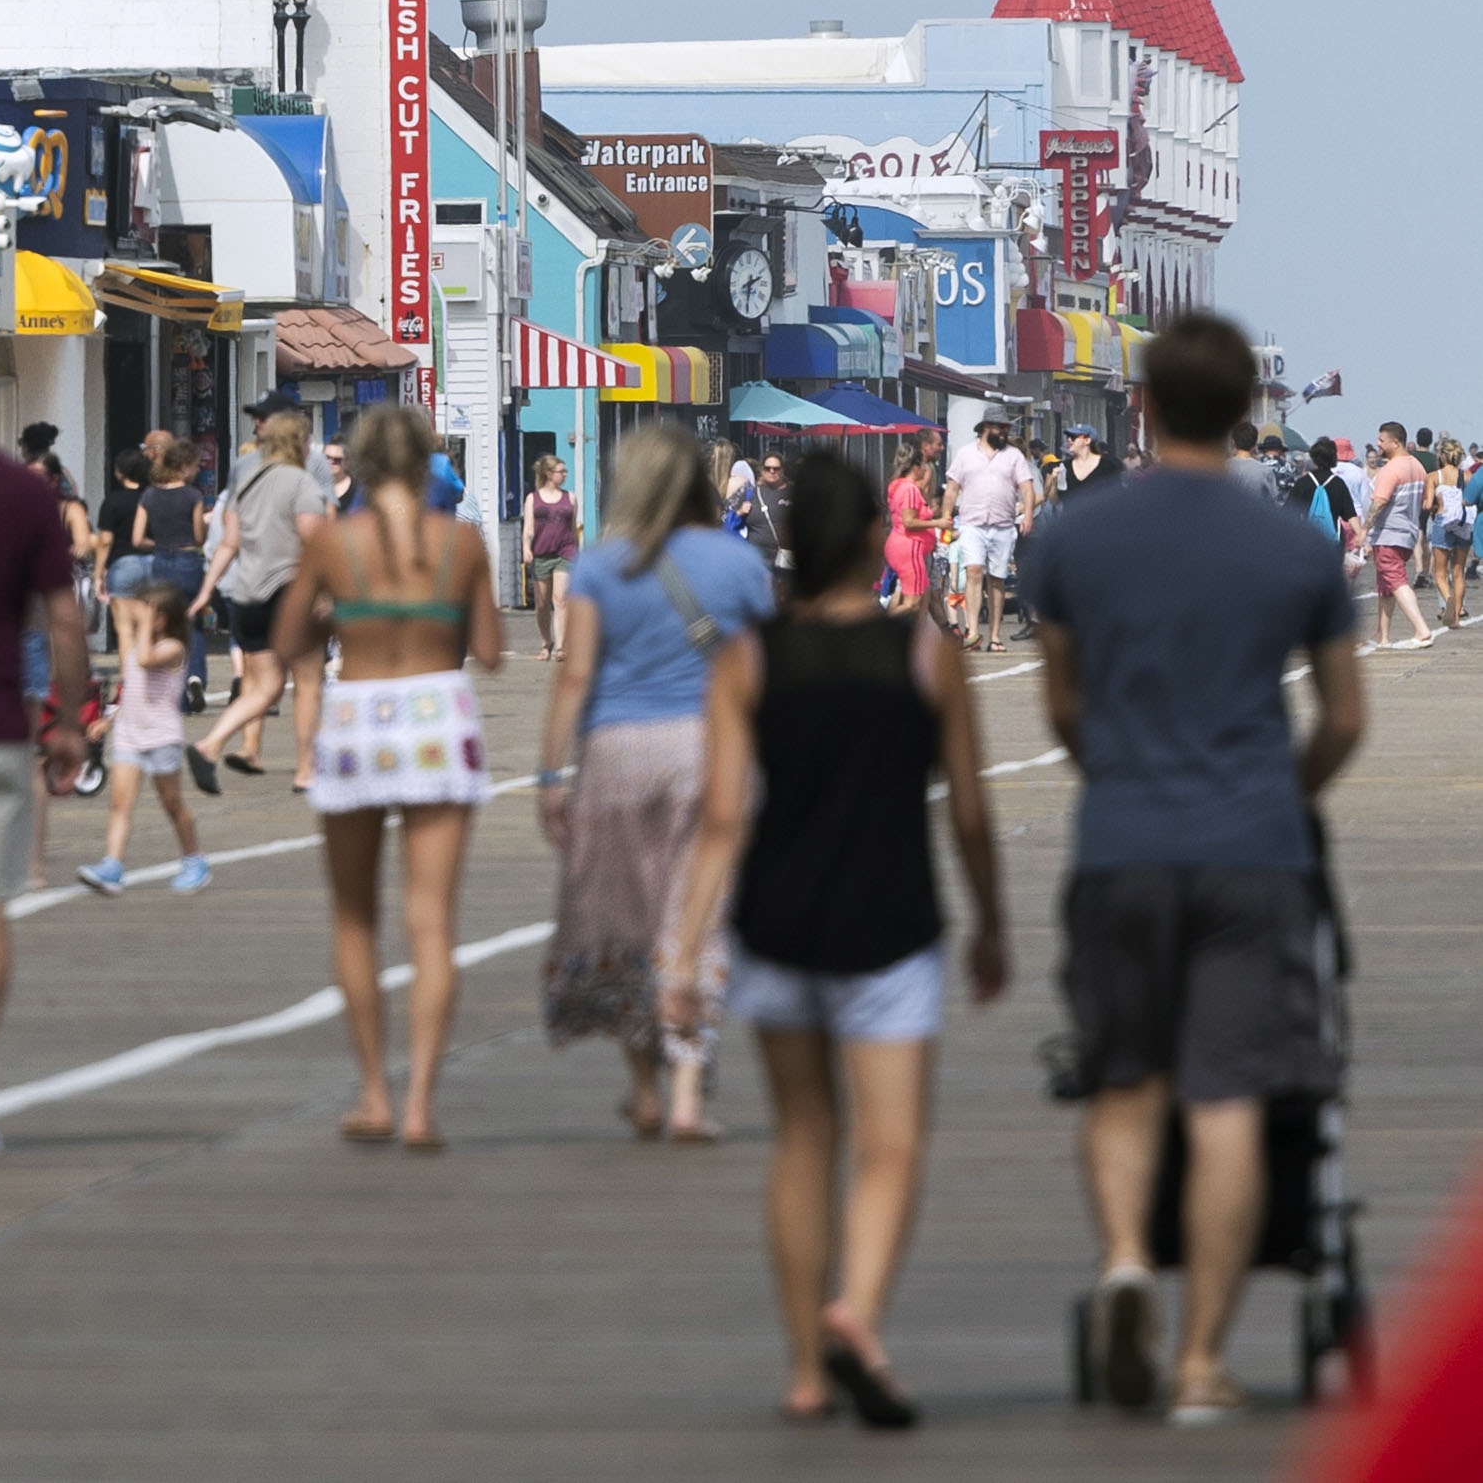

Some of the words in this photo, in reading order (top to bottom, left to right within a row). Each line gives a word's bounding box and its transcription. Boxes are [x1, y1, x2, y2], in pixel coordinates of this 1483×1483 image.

[398, 75, 420, 155] CUT
[581, 139, 706, 169] Waterpark
[625, 172, 709, 193] Entrance
[399, 172, 422, 305] FRIES
[1070, 156, 1090, 270] POPCORN
[421, 369, 431, 410] FRE
